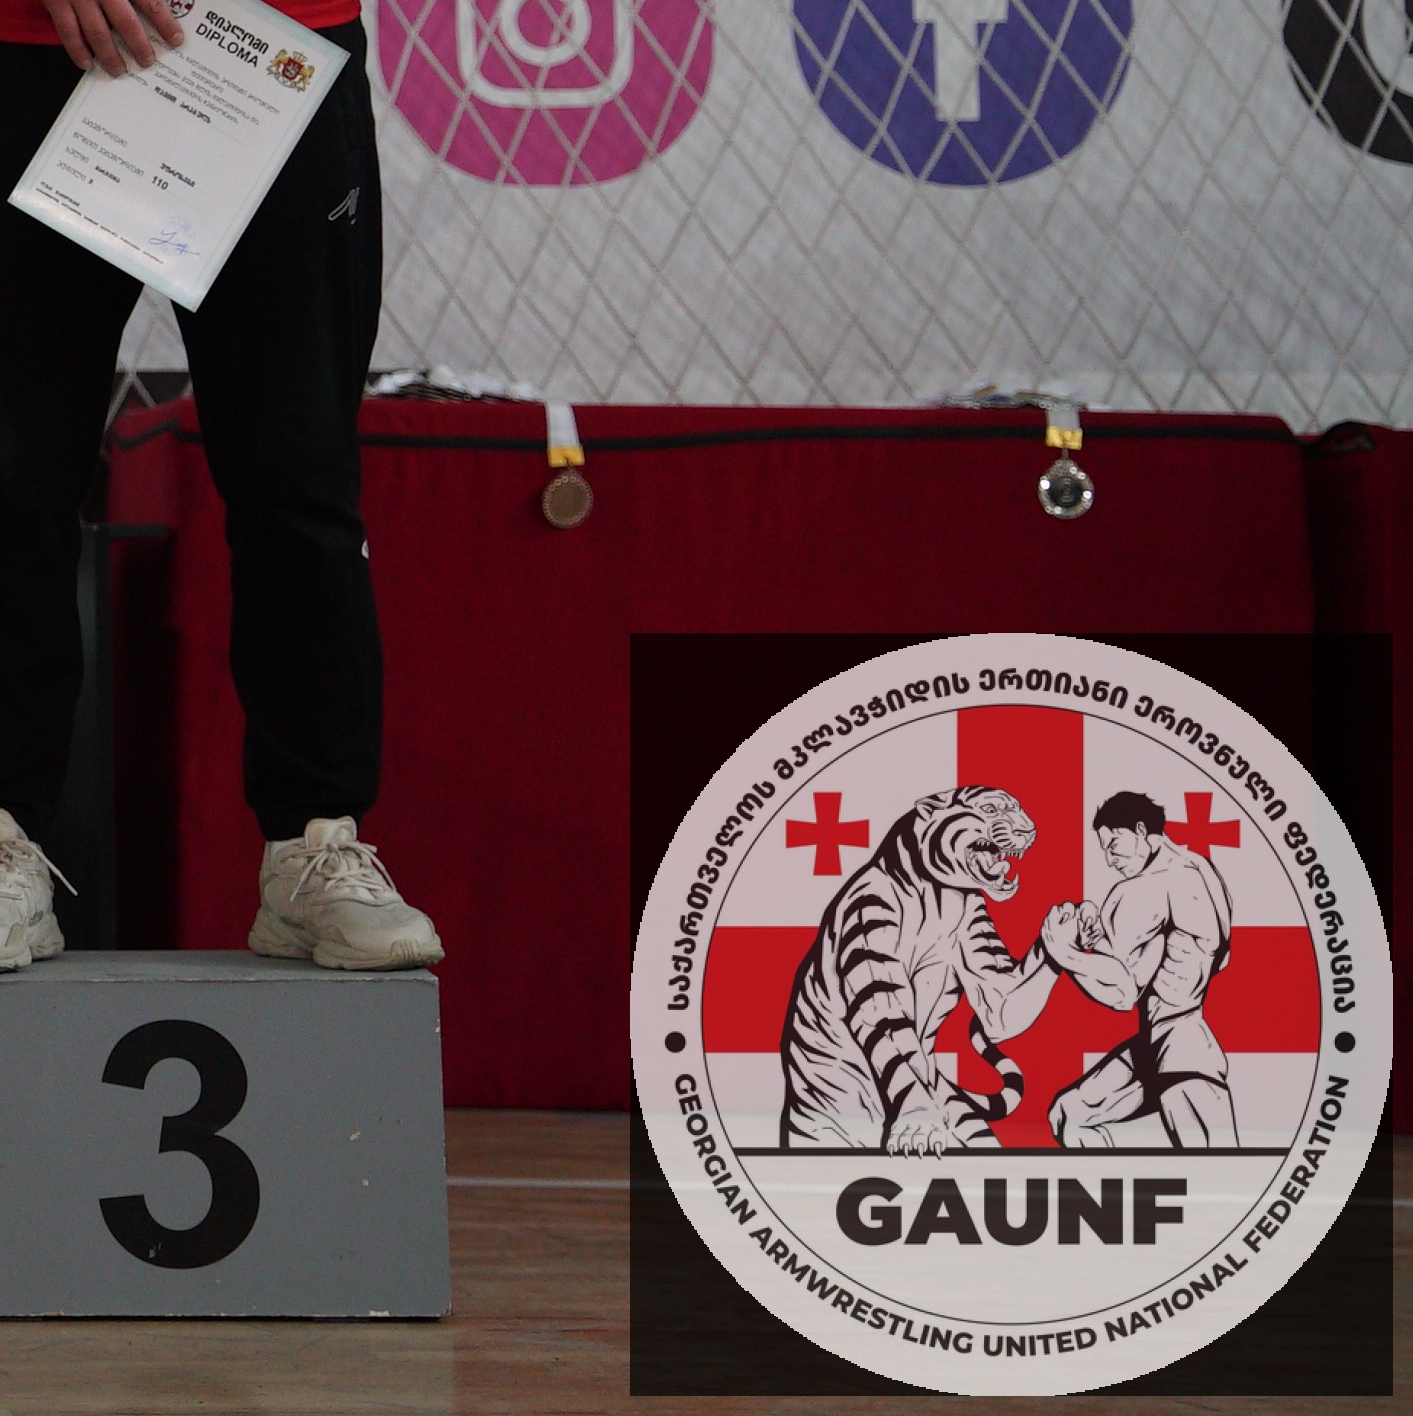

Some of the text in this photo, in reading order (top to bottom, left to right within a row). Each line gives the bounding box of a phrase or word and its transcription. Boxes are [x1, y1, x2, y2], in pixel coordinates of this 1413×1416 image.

[195, 22, 259, 68] DIPLOMA
[205, 10, 269, 55] დიპლომი
[151, 175, 169, 191] 110
[99, 1019, 260, 1270] 3
